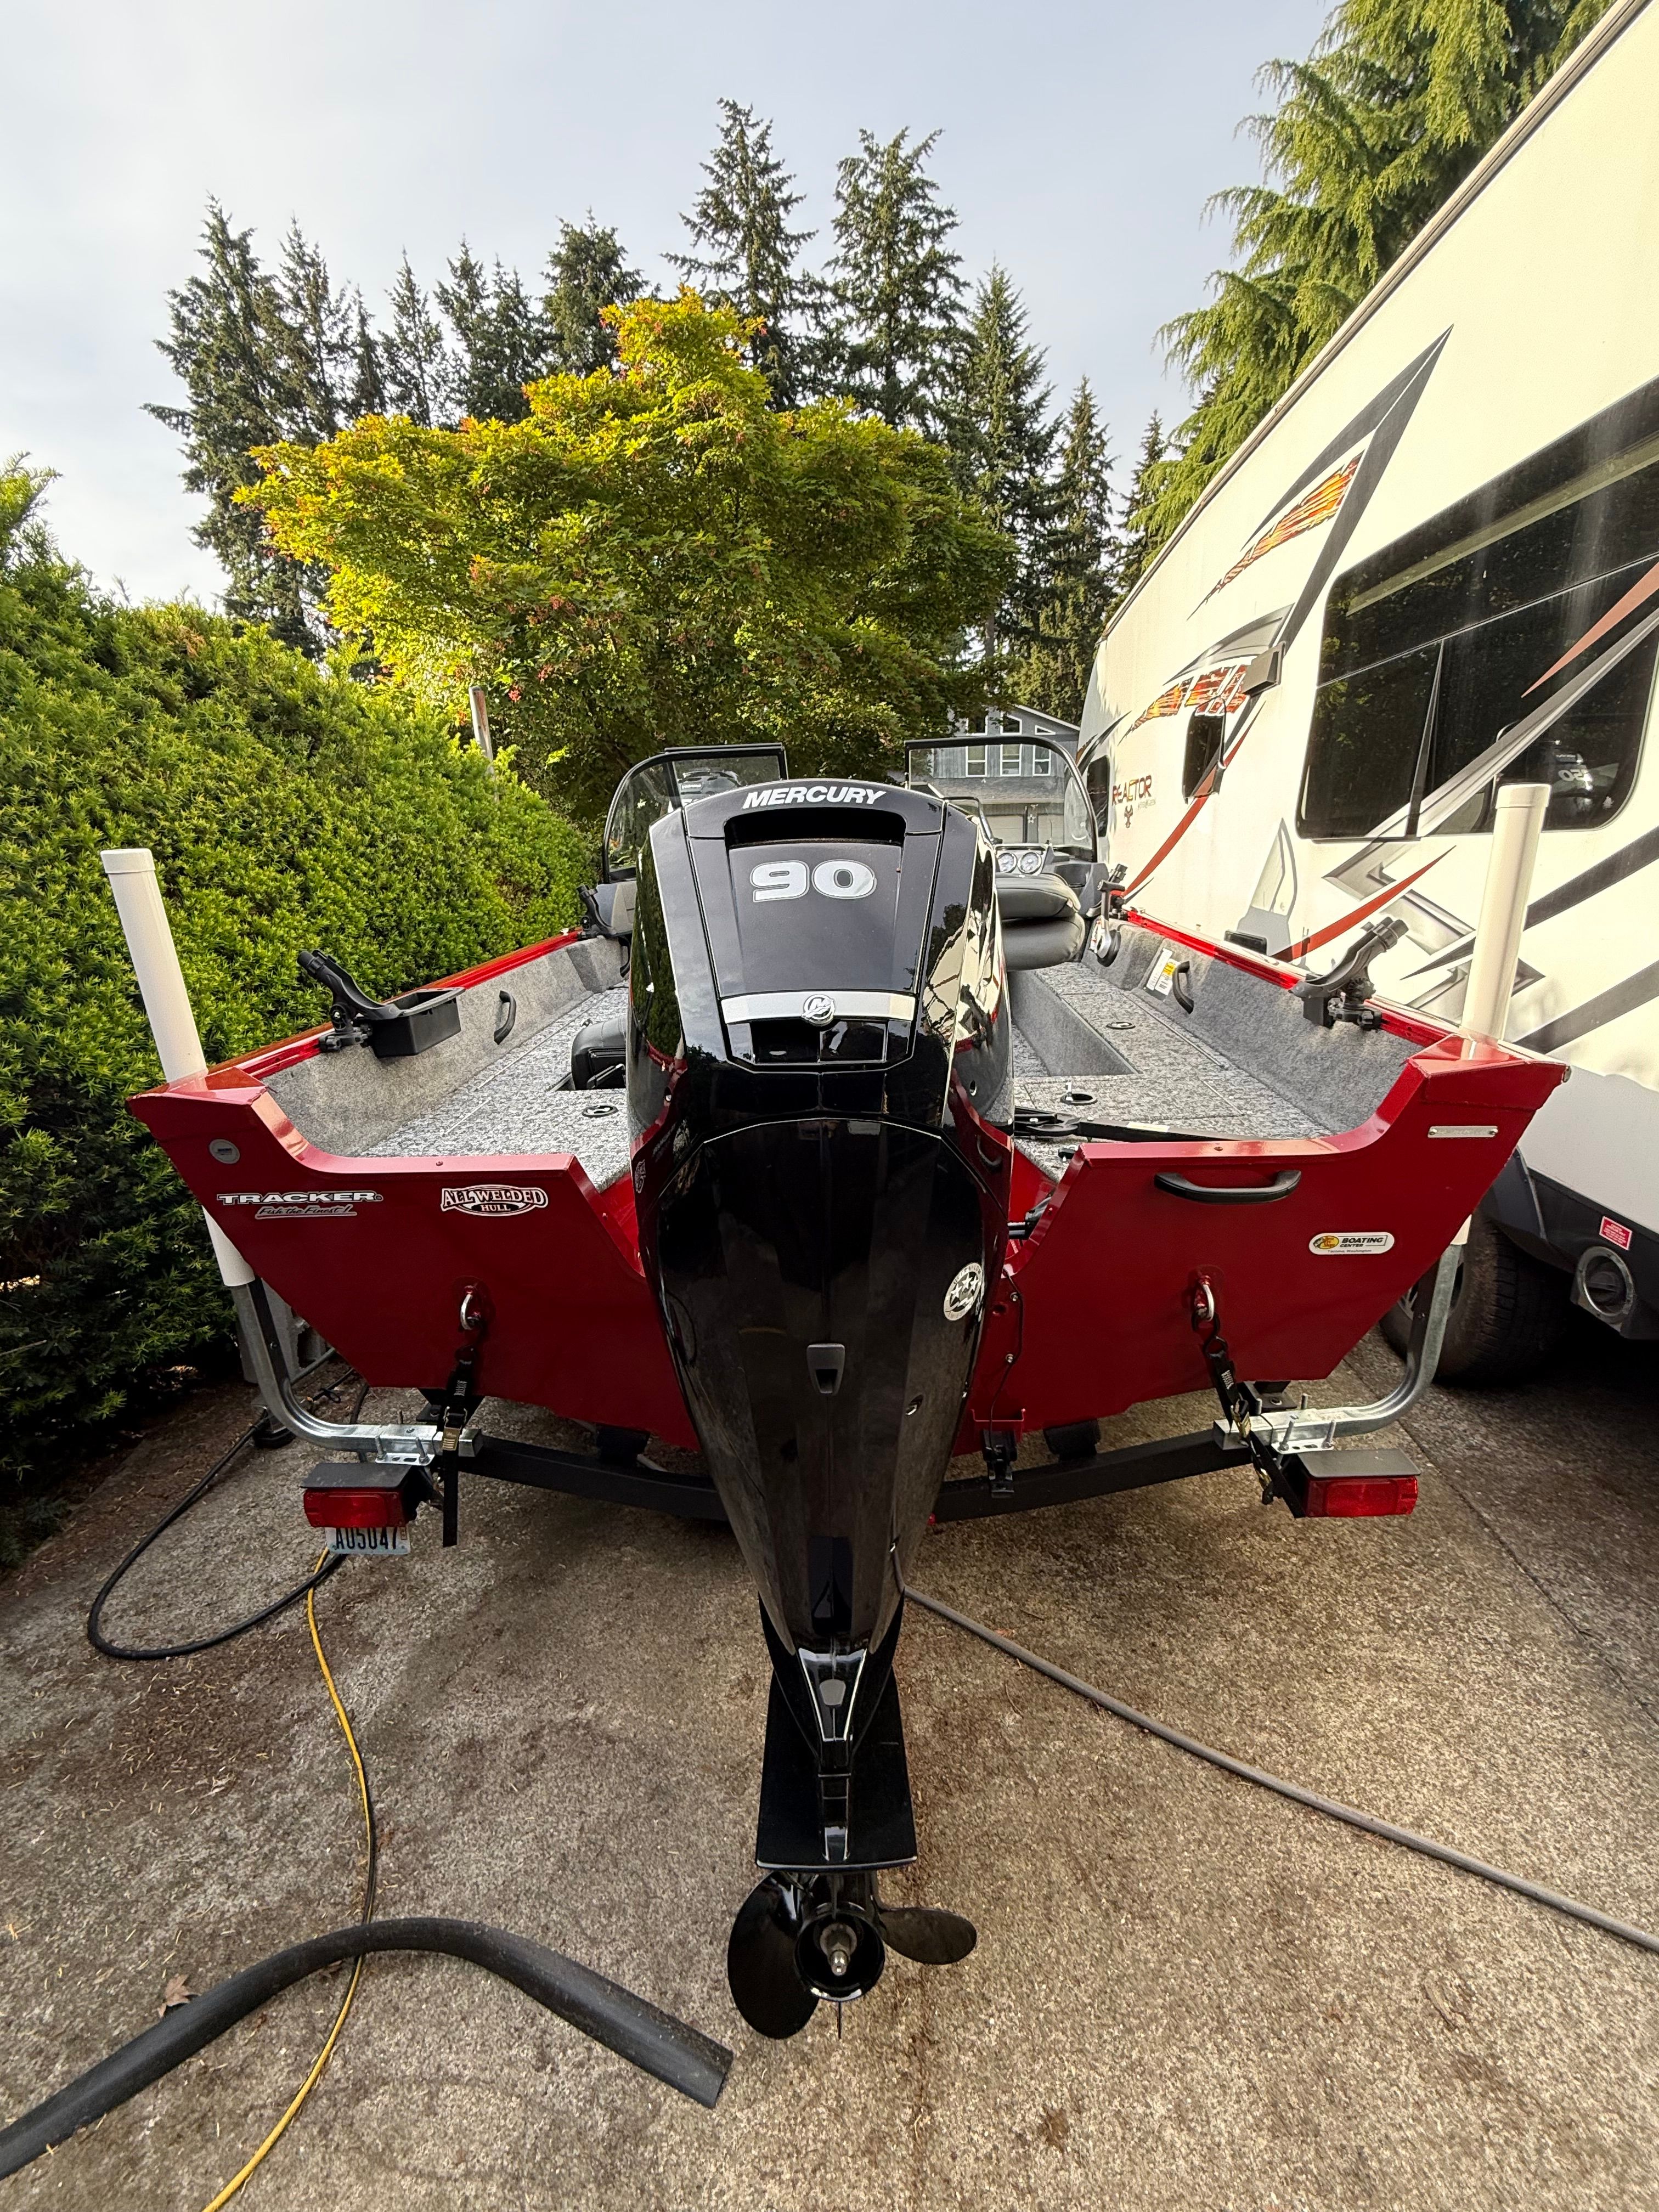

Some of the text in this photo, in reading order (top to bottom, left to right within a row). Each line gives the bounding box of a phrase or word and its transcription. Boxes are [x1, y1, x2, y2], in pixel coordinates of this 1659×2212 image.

[742, 786, 887, 809] MERCURY
[1112, 775, 1152, 806] REACTOR
[749, 859, 877, 902] 90
[218, 1192, 376, 1204] TRACKER
[259, 1206, 284, 1215] Fish
[286, 1206, 303, 1214] the
